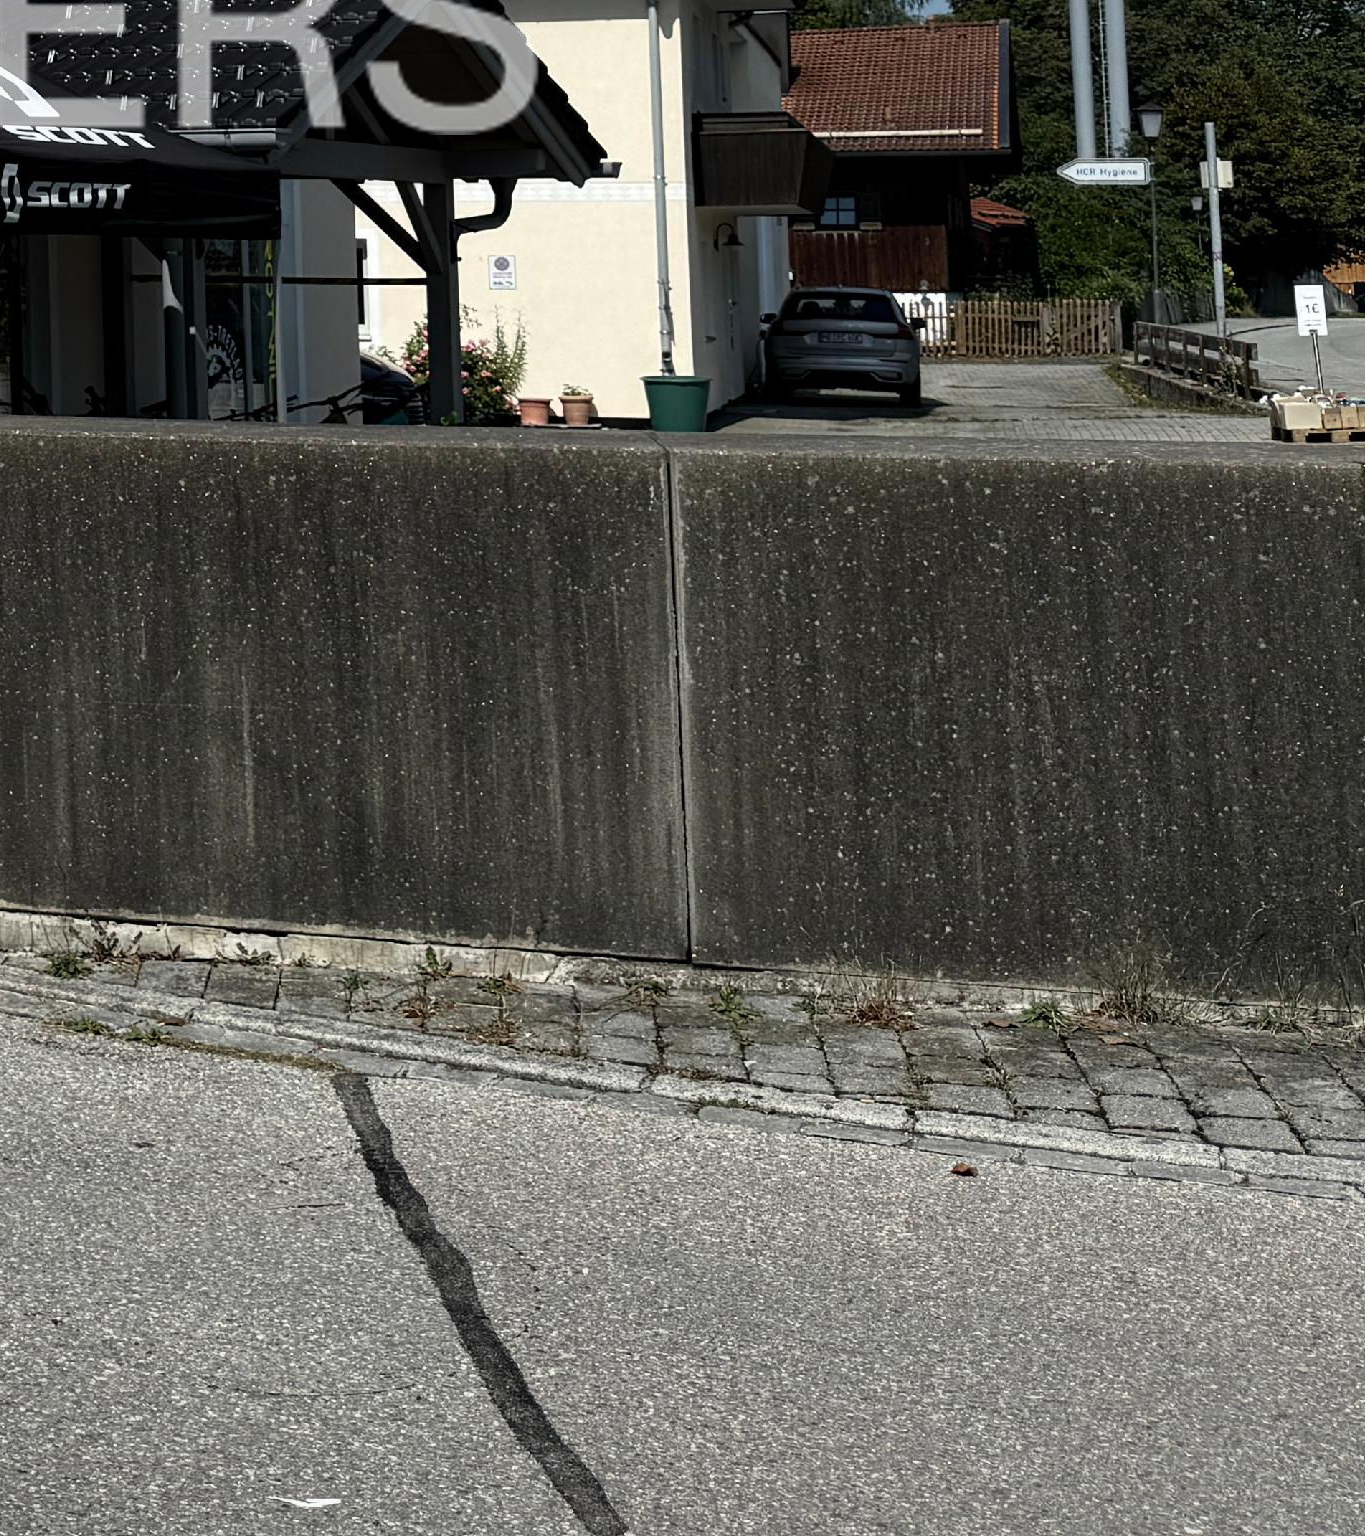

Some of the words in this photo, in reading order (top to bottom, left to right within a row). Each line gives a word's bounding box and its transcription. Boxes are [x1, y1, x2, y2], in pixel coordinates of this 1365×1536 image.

[3, 124, 157, 150] SCOTT
[1099, 167, 1139, 177] Hygiene
[27, 181, 132, 210] SCOTT
